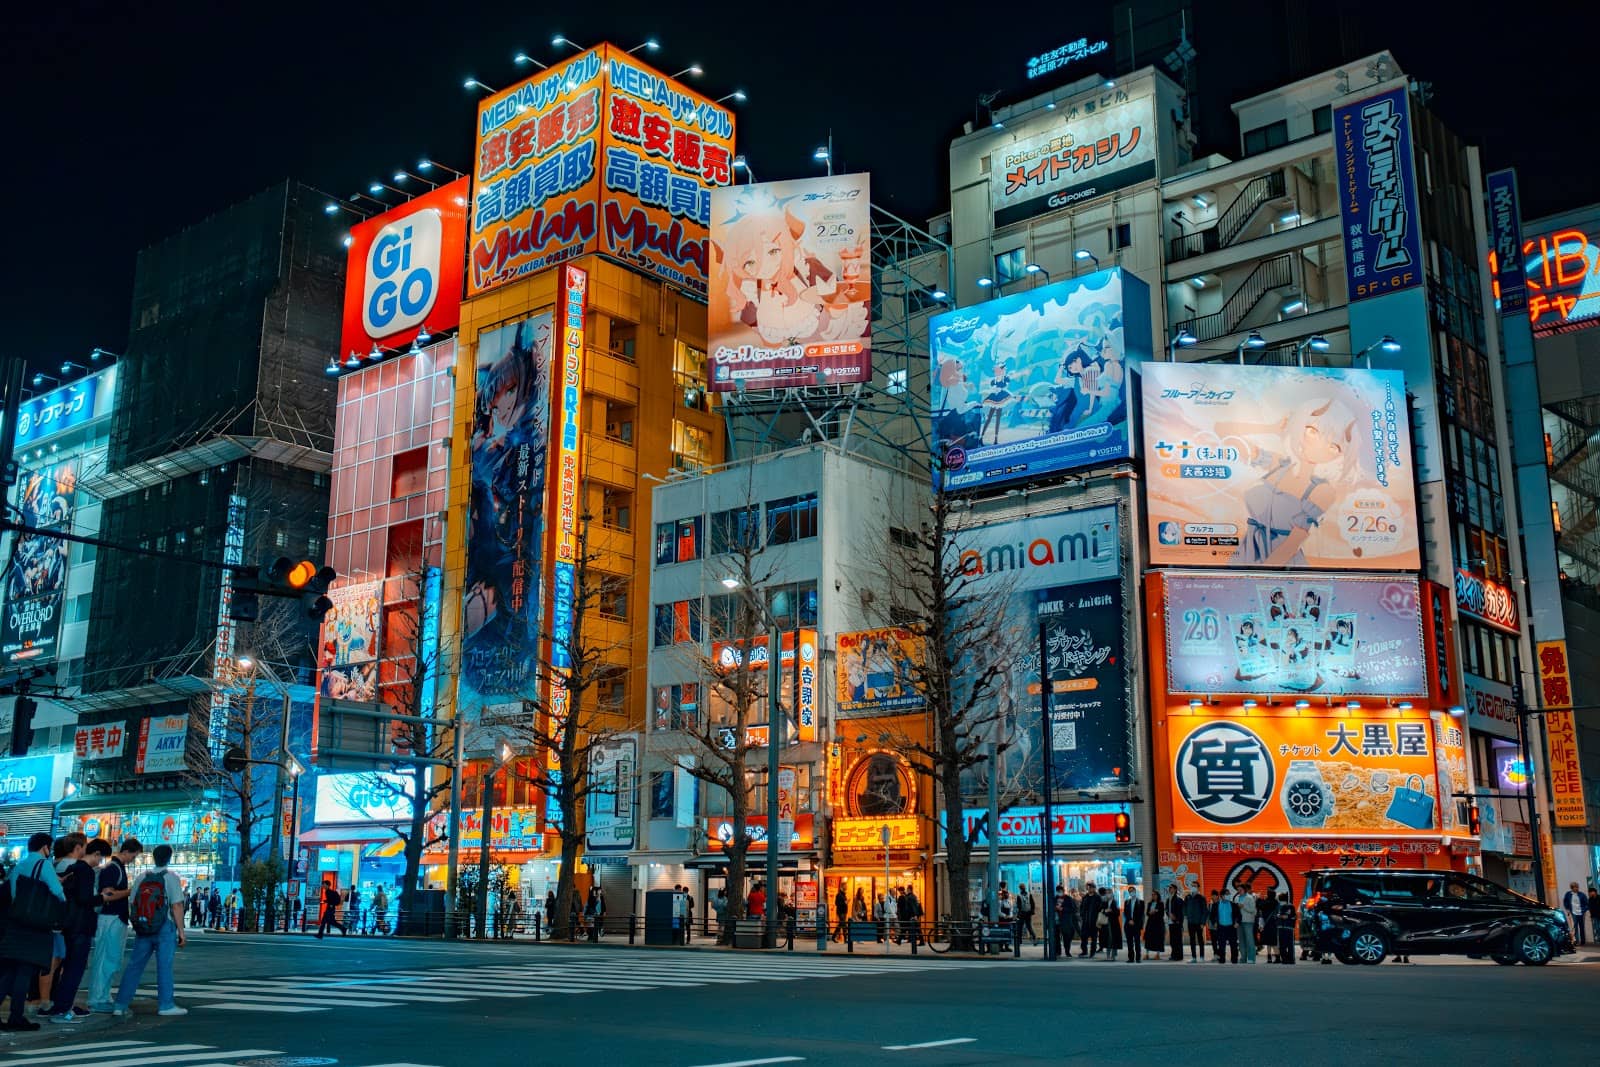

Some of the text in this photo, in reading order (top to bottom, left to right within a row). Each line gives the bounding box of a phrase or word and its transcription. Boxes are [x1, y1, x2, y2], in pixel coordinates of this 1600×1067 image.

[1027, 40, 1108, 79] 秋葉原ファーストビル
[1040, 38, 1088, 64] 住友不動産
[481, 51, 600, 136] MEDIAリサイクル
[610, 58, 732, 139] MEDIAリサイクル
[480, 88, 598, 181] 激安販売
[610, 92, 731, 186] 激安販売
[1006, 133, 1074, 168] Pokerの聖地
[475, 139, 595, 233] 高額買取
[1006, 127, 1141, 195] メイドカジノ
[474, 200, 596, 288] Mulan
[1351, 223, 1366, 278] 秋葉原店
[369, 268, 432, 328] GO
[33, 391, 85, 426] ソフマップ
[532, 322, 549, 487] ヘブンバーンズレッド
[1160, 388, 1236, 400] ブルーアーカイブ
[511, 444, 531, 613] 最新ストーリー配信中
[1347, 515, 1388, 532] 2/26
[959, 529, 1099, 576] amiami
[10, 605, 53, 629] OVERLORD
[800, 665, 814, 727] 吉野家
[1540, 647, 1569, 706] 免税
[75, 725, 122, 757] 営業中
[1279, 722, 1428, 756] チケット 大黒屋
[1561, 709, 1574, 743] TAX
[1183, 736, 1267, 810] 質
[1565, 749, 1580, 793] FREE
[1064, 815, 1091, 833] ZIN
[1340, 854, 1397, 866] チケット
